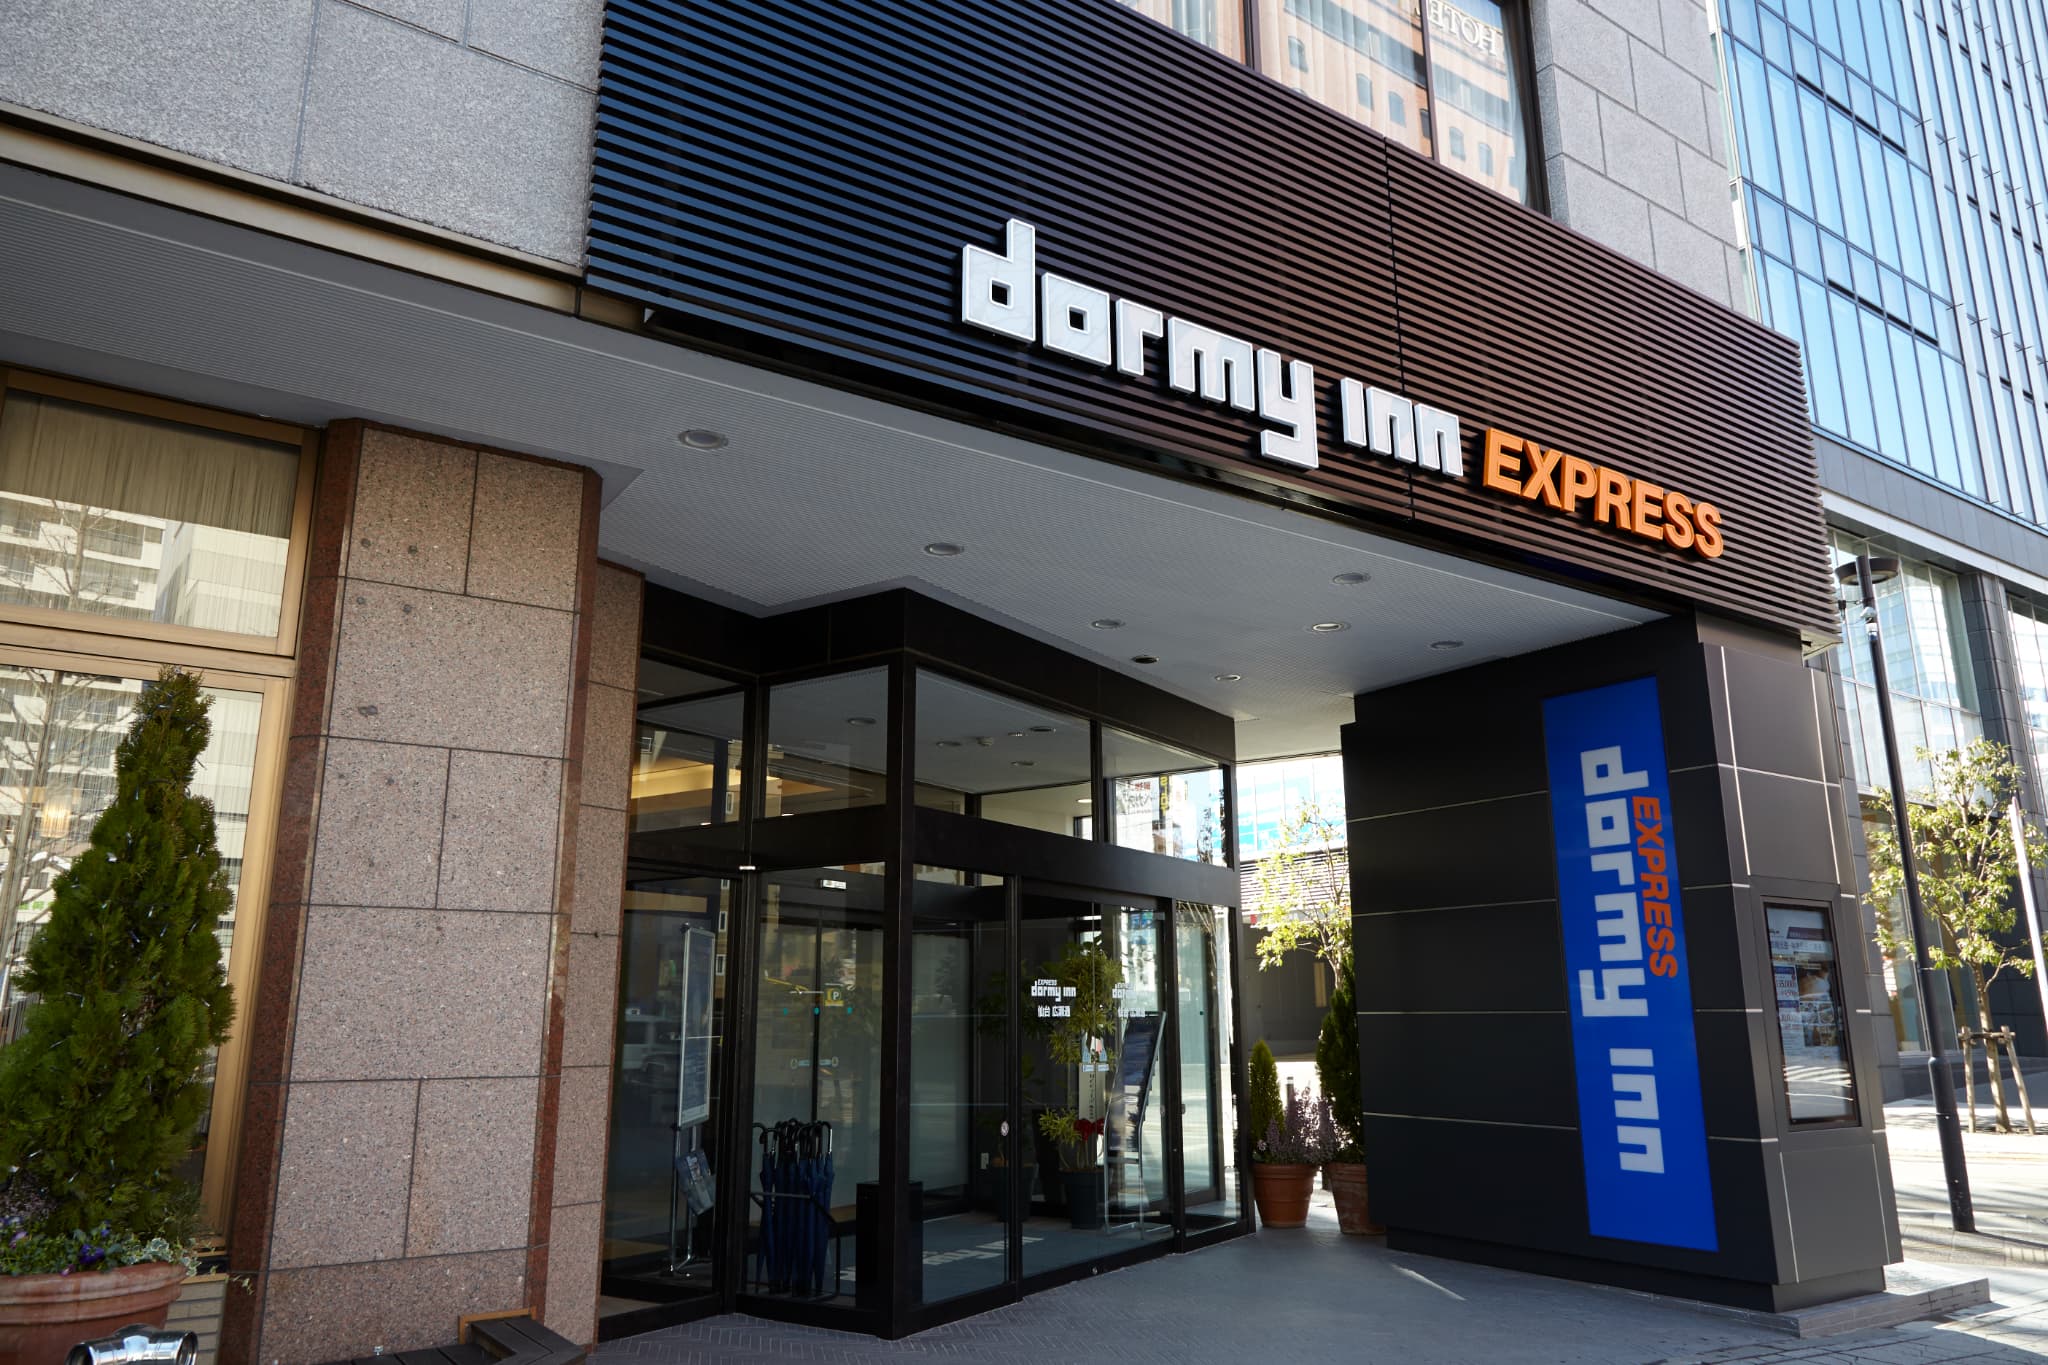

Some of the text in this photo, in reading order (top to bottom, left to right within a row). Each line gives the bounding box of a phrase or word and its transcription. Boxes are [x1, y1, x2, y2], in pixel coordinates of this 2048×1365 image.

[962, 218, 1464, 477] dormy inn
[1484, 426, 1724, 560] EXPRESS
[1579, 745, 1665, 1174] dormy inn
[1632, 795, 1678, 979] EXPRESS
[1031, 980, 1077, 1002] dormy inn
